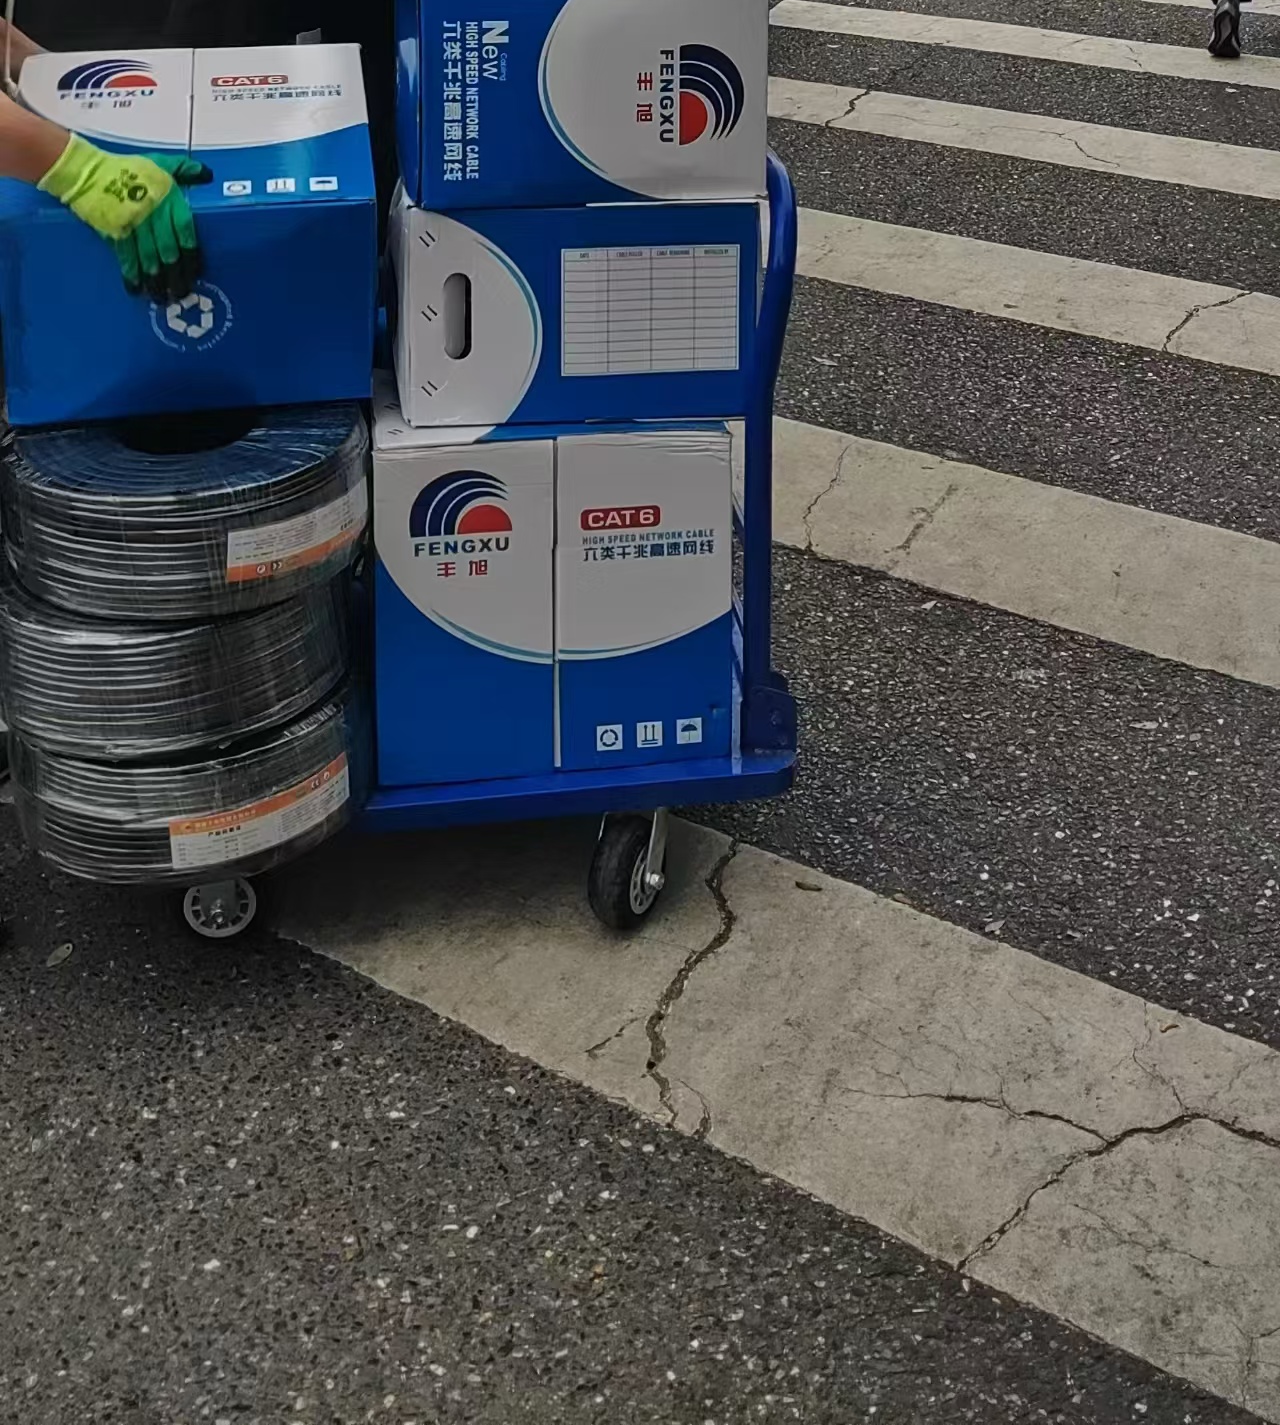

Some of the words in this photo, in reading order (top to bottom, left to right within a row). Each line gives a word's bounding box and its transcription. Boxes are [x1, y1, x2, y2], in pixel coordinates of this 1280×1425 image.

[465, 21, 479, 48] HIGH
[482, 20, 510, 80] New
[466, 51, 479, 84] SPEED
[217, 77, 264, 86] CAT
[267, 76, 284, 85] 6
[60, 89, 155, 101] FENGXU
[443, 20, 462, 182] 六类千兆高速网线
[659, 49, 675, 144] FENGXU
[466, 87, 479, 140] NETWORK
[466, 145, 479, 180] CABLE
[588, 510, 636, 528] CAT
[639, 508, 655, 525] 6
[414, 536, 510, 557] FENGXU
[582, 535, 605, 545] HIGH
[607, 533, 637, 544] SPEED
[639, 530, 683, 542] NETWORK
[685, 528, 715, 539] CABLE
[583, 539, 714, 562] 六类千兆高速网线
[436, 559, 489, 578] 丰旭
